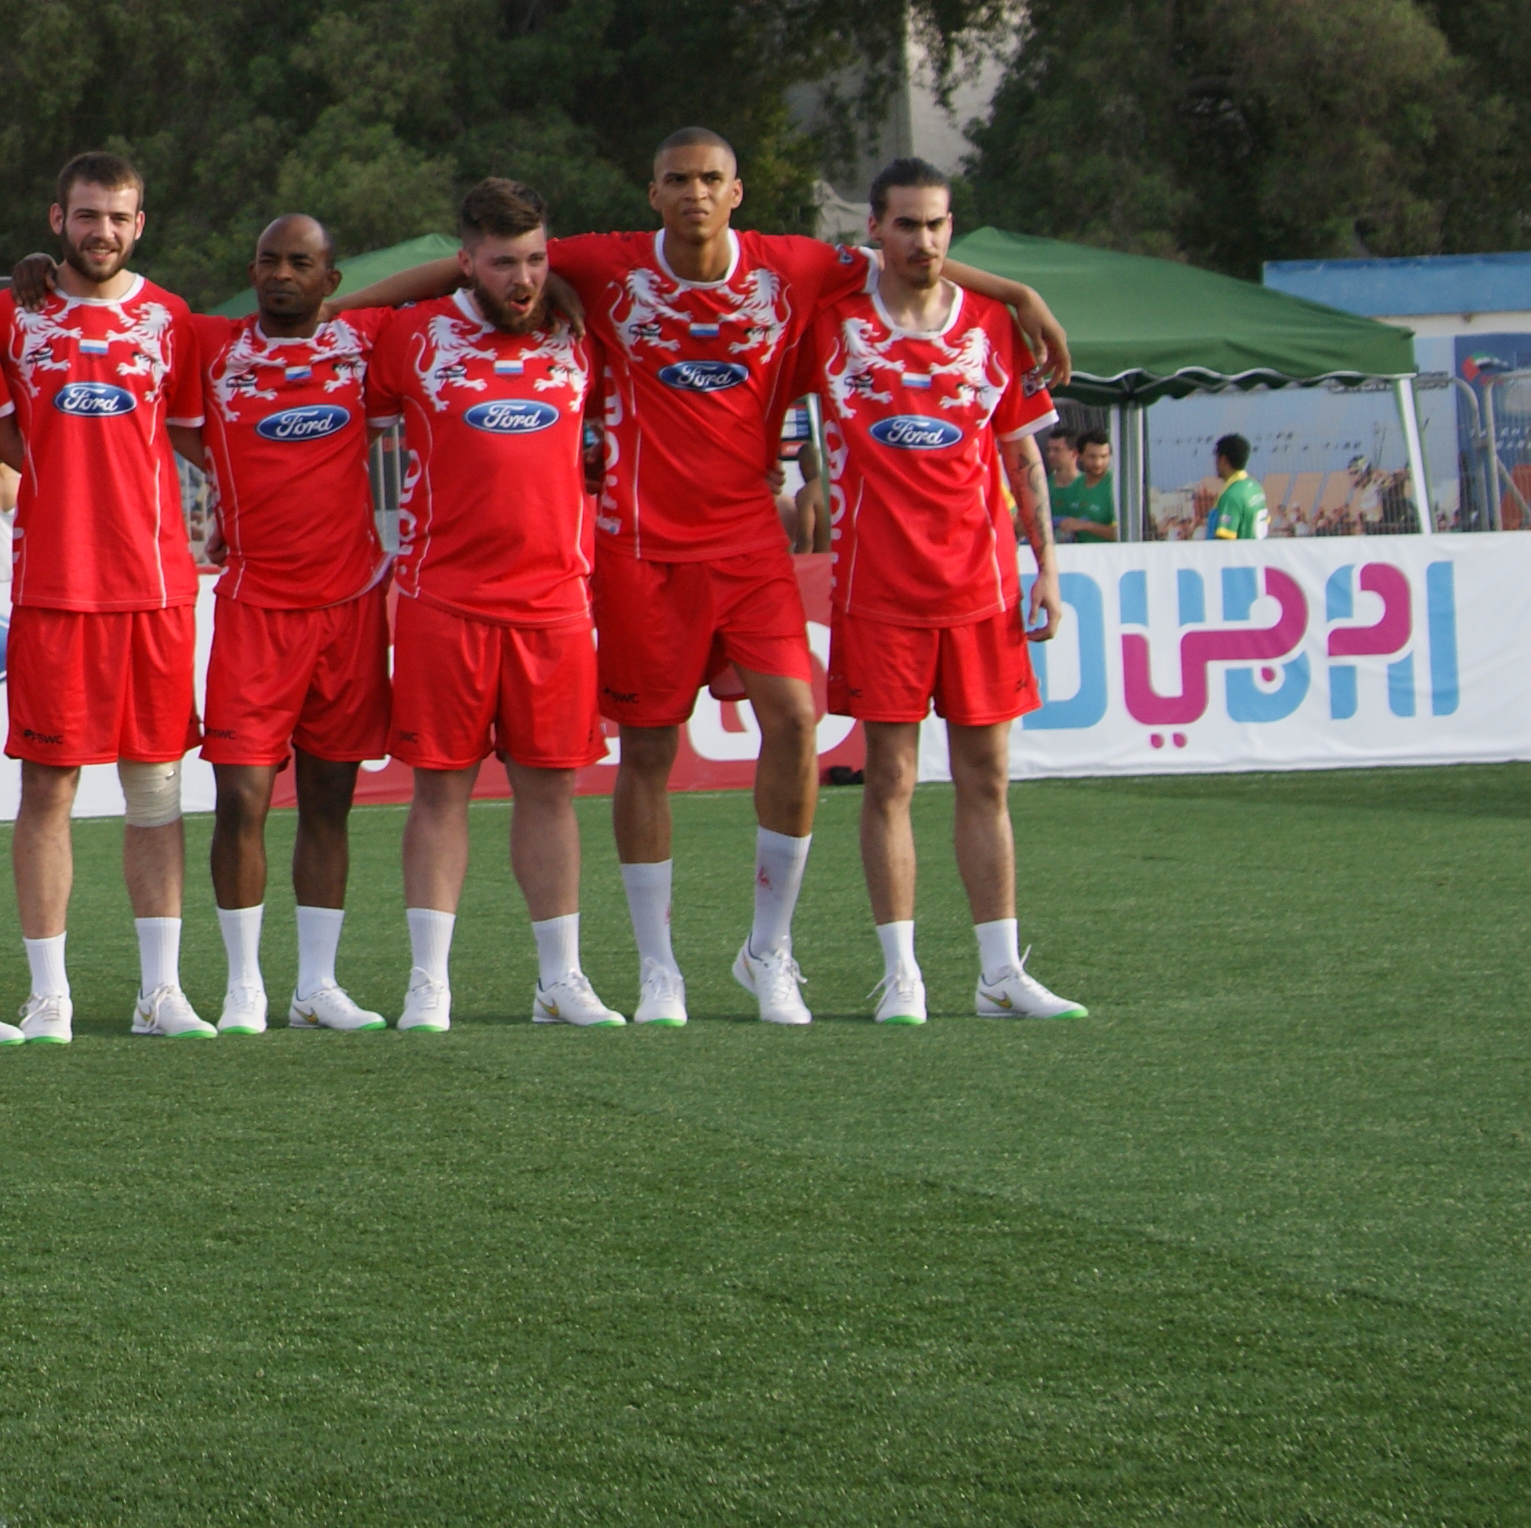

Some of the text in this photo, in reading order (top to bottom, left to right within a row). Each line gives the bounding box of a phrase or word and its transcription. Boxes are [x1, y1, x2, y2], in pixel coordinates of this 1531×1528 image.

[677, 364, 733, 386] Ford
[64, 386, 120, 412] Ford
[275, 410, 335, 437] Ford
[483, 404, 542, 428] Ford
[887, 421, 945, 445] Ford
